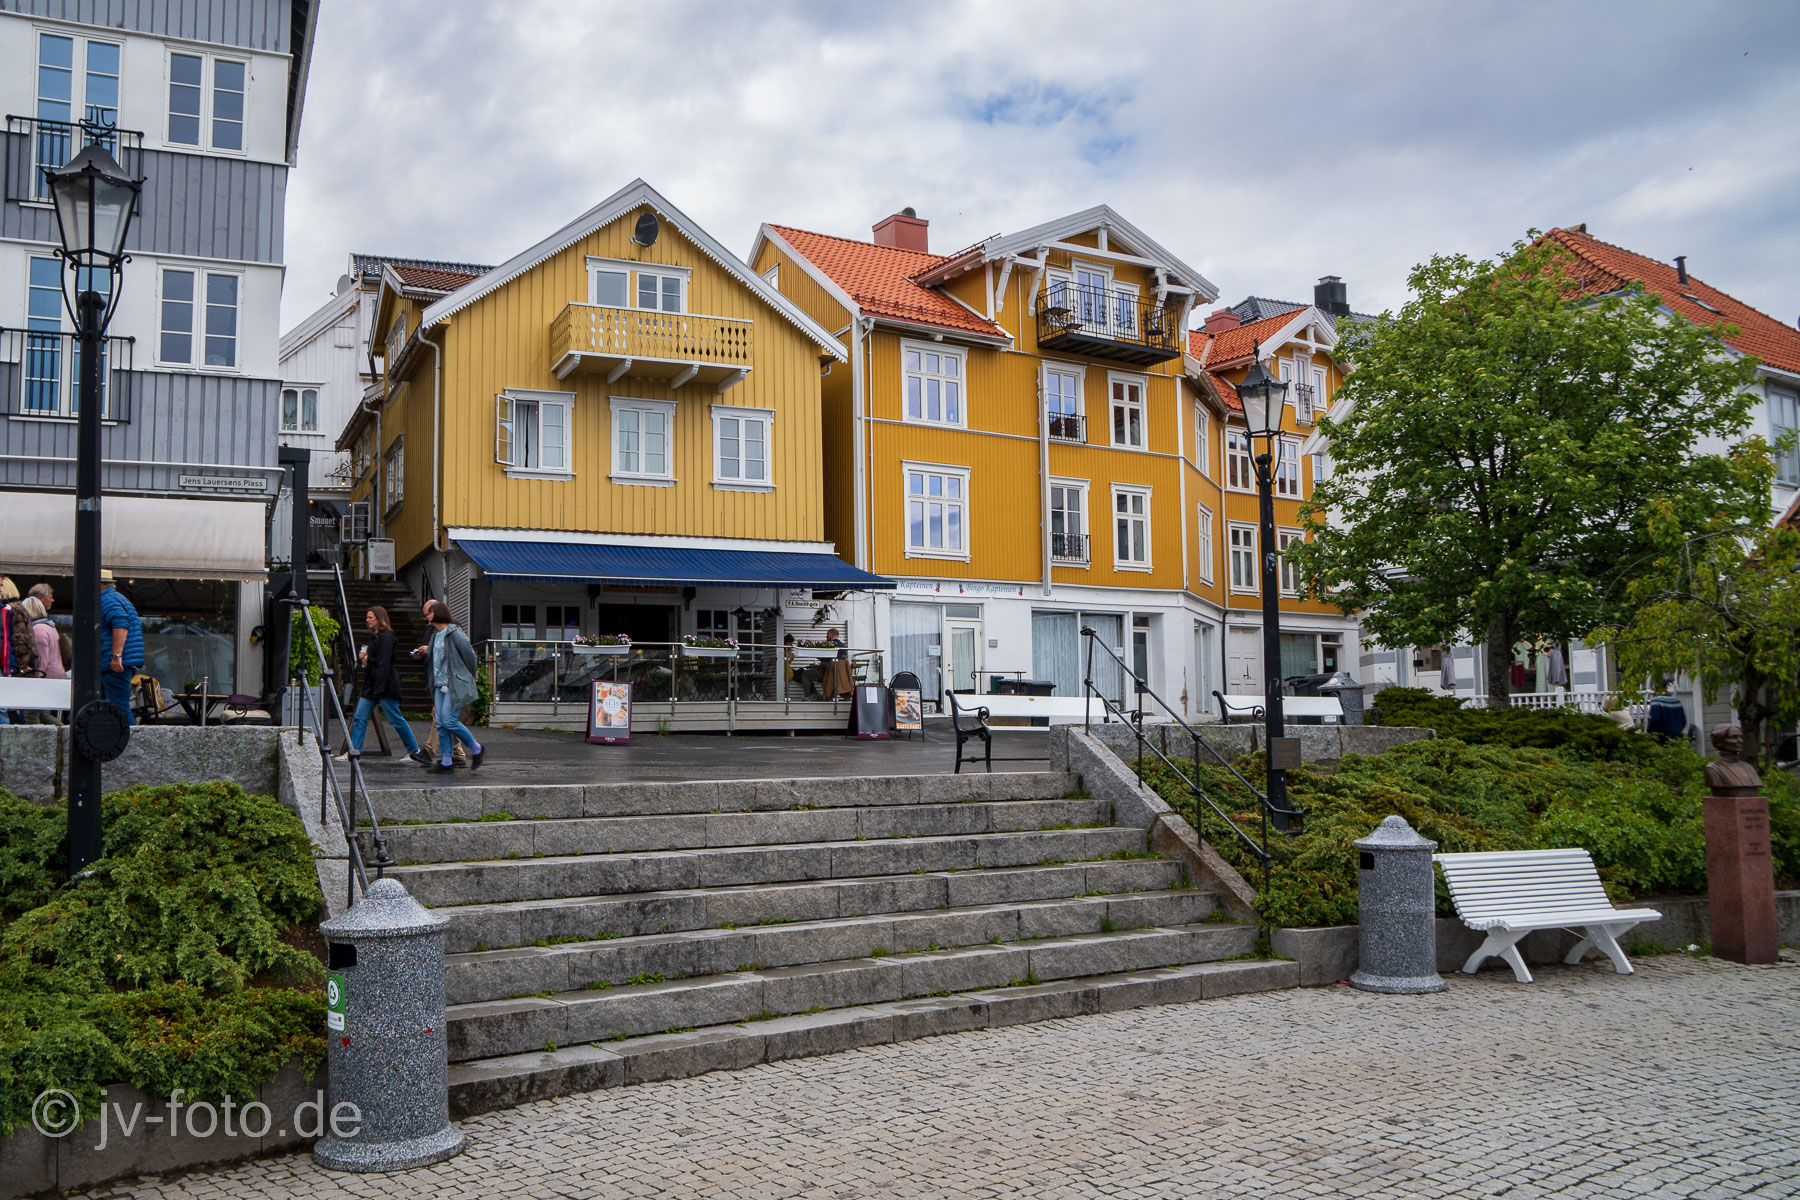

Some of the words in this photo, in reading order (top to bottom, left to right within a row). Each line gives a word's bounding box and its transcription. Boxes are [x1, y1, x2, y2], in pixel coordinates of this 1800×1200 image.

[203, 478, 242, 486] Lauersøns
[309, 516, 336, 525] Smauet
[900, 580, 934, 590] Kapteinen
[966, 583, 985, 593] Bingo
[985, 584, 1017, 594] Kapteinen
